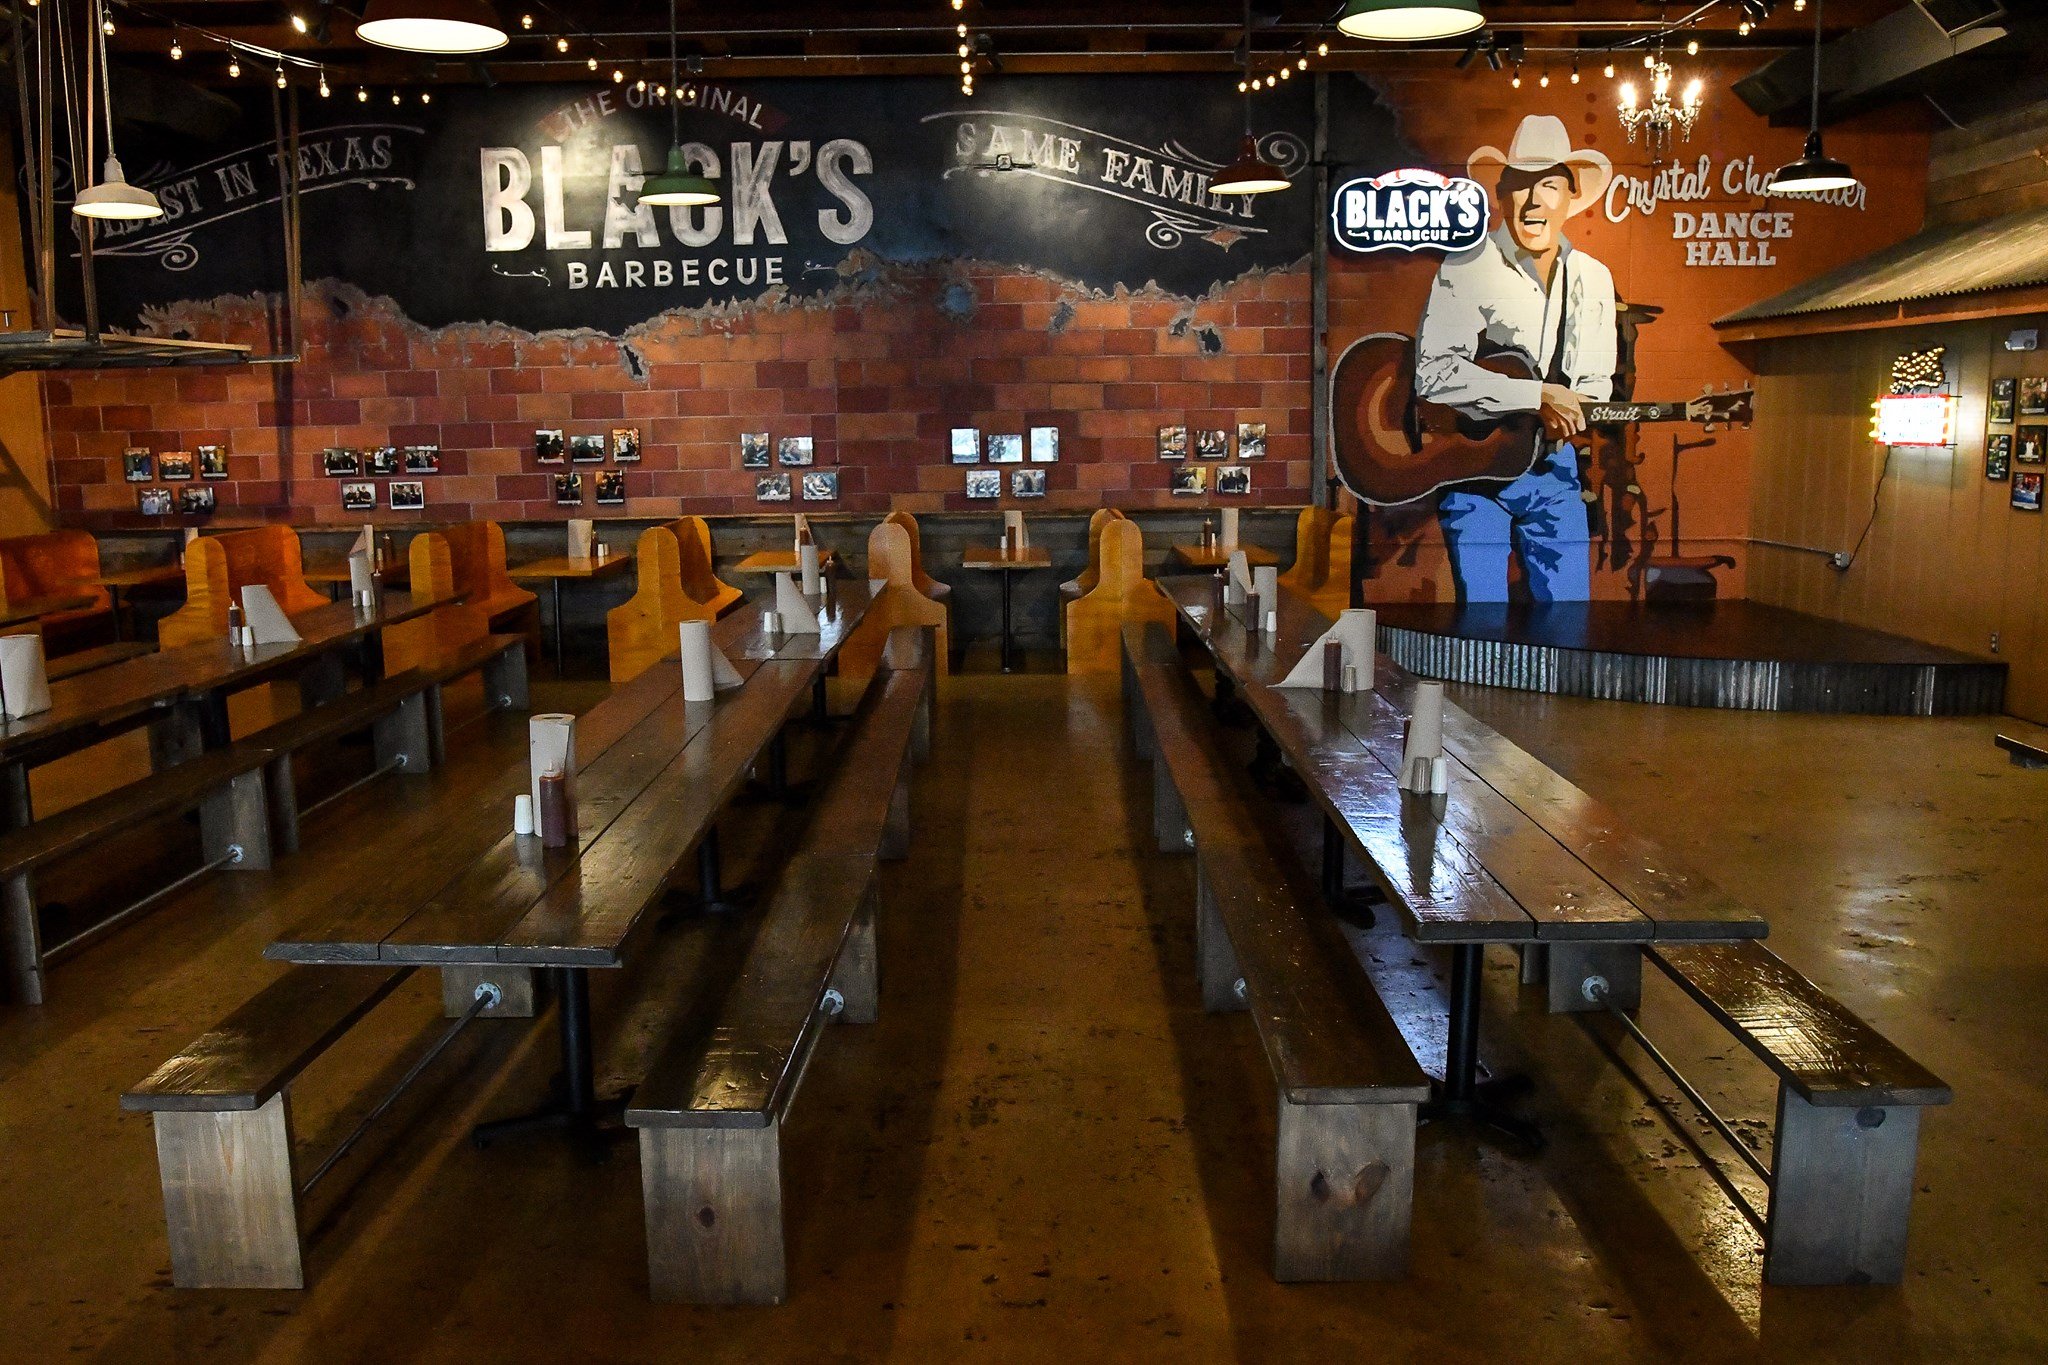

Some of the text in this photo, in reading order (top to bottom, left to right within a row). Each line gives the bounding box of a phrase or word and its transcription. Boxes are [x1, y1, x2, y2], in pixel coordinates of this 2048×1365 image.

[559, 82, 762, 129] THE ORGINAL
[956, 122, 1256, 218] SAME FAMILY
[1604, 154, 1866, 223] Crystal Chaer
[71, 176, 202, 243] OLST
[215, 160, 260, 202] IN
[480, 138, 874, 252] BLACK'S
[1345, 189, 1480, 228] BLACK'S
[1373, 229, 1450, 242] BARBECUE
[1673, 212, 1794, 238] DANCE
[568, 256, 784, 289] BARBECUE
[1685, 241, 1777, 266] HALL
[1590, 406, 1641, 421] Strait
